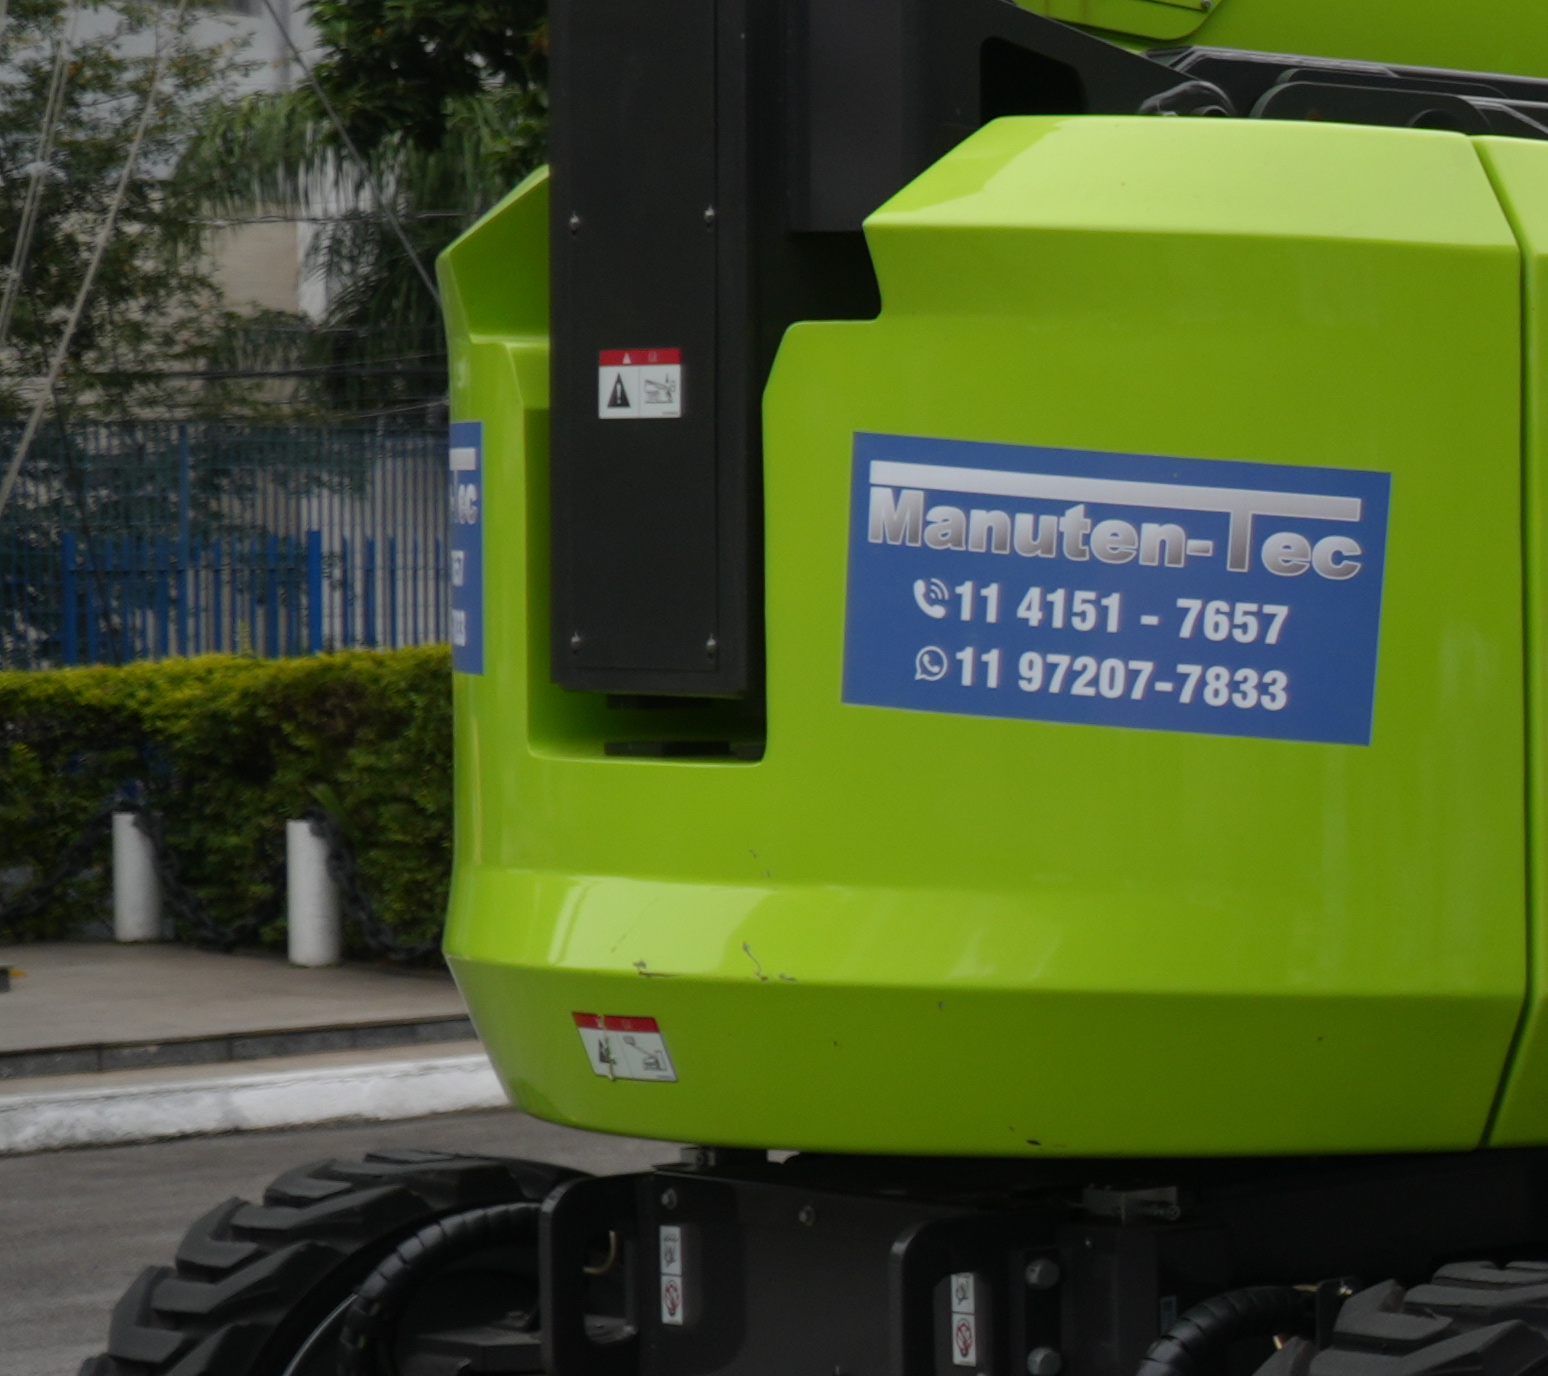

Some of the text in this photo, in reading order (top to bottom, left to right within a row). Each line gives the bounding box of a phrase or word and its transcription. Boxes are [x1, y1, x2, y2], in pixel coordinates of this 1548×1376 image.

[867, 460, 1362, 580] Manuten-Tec
[955, 581, 1000, 624] 11
[1017, 586, 1121, 633] 4151
[1176, 599, 1289, 645] 7657
[956, 647, 1288, 711] 11 97207-7833
